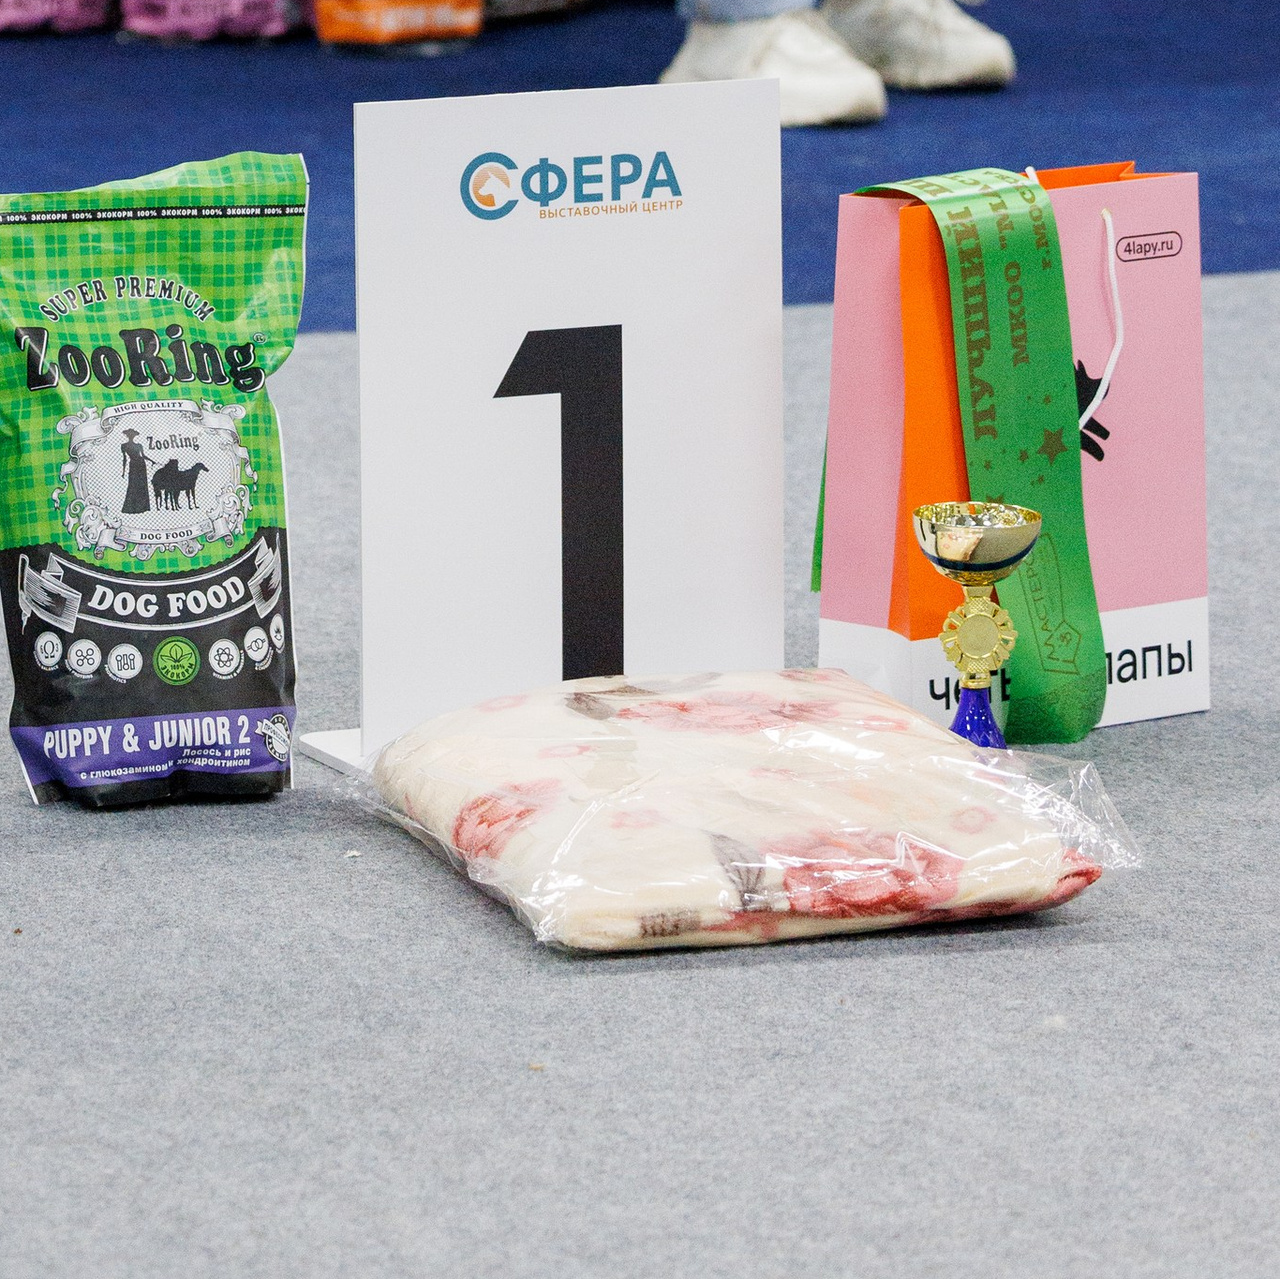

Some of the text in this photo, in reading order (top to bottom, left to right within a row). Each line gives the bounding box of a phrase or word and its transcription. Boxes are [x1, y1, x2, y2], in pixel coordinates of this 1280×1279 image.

[460, 151, 683, 220] СФЕРА
[6, 214, 27, 223] 100%
[31, 213, 68, 222] ЭКОКОРМ
[71, 212, 93, 220] 100%
[96, 211, 133, 219] ЭКОКОРМ
[226, 207, 261, 215] ЭКОКОРМ
[264, 207, 282, 215] 100%
[539, 200, 683, 219] ВЫСТАВОЧНЫЙ ЦЕНТР
[1124, 240, 1174, 256] 4lapy.ru
[39, 275, 216, 322] SUPER PREMIUM
[944, 206, 998, 441] ЛУЧШИЙ
[1004, 261, 1030, 367] МКОО
[14, 324, 266, 393] ZooRing
[114, 402, 184, 413] HIGH QUALITY
[147, 434, 200, 451] ZooRing
[493, 324, 624, 682] 1
[140, 529, 193, 540] DOG FOOD
[88, 576, 245, 618] DOG FOOD
[160, 662, 196, 680] ЭКОКОРМ
[44, 725, 112, 759] PUPPY
[122, 723, 140, 753] &
[148, 716, 231, 750] JUNIOR
[237, 715, 251, 744] 2
[182, 747, 251, 757] Лосось и рис
[80, 771, 87, 780] с
[90, 763, 168, 779] глюкозамином
[177, 756, 251, 768] хондроитином
